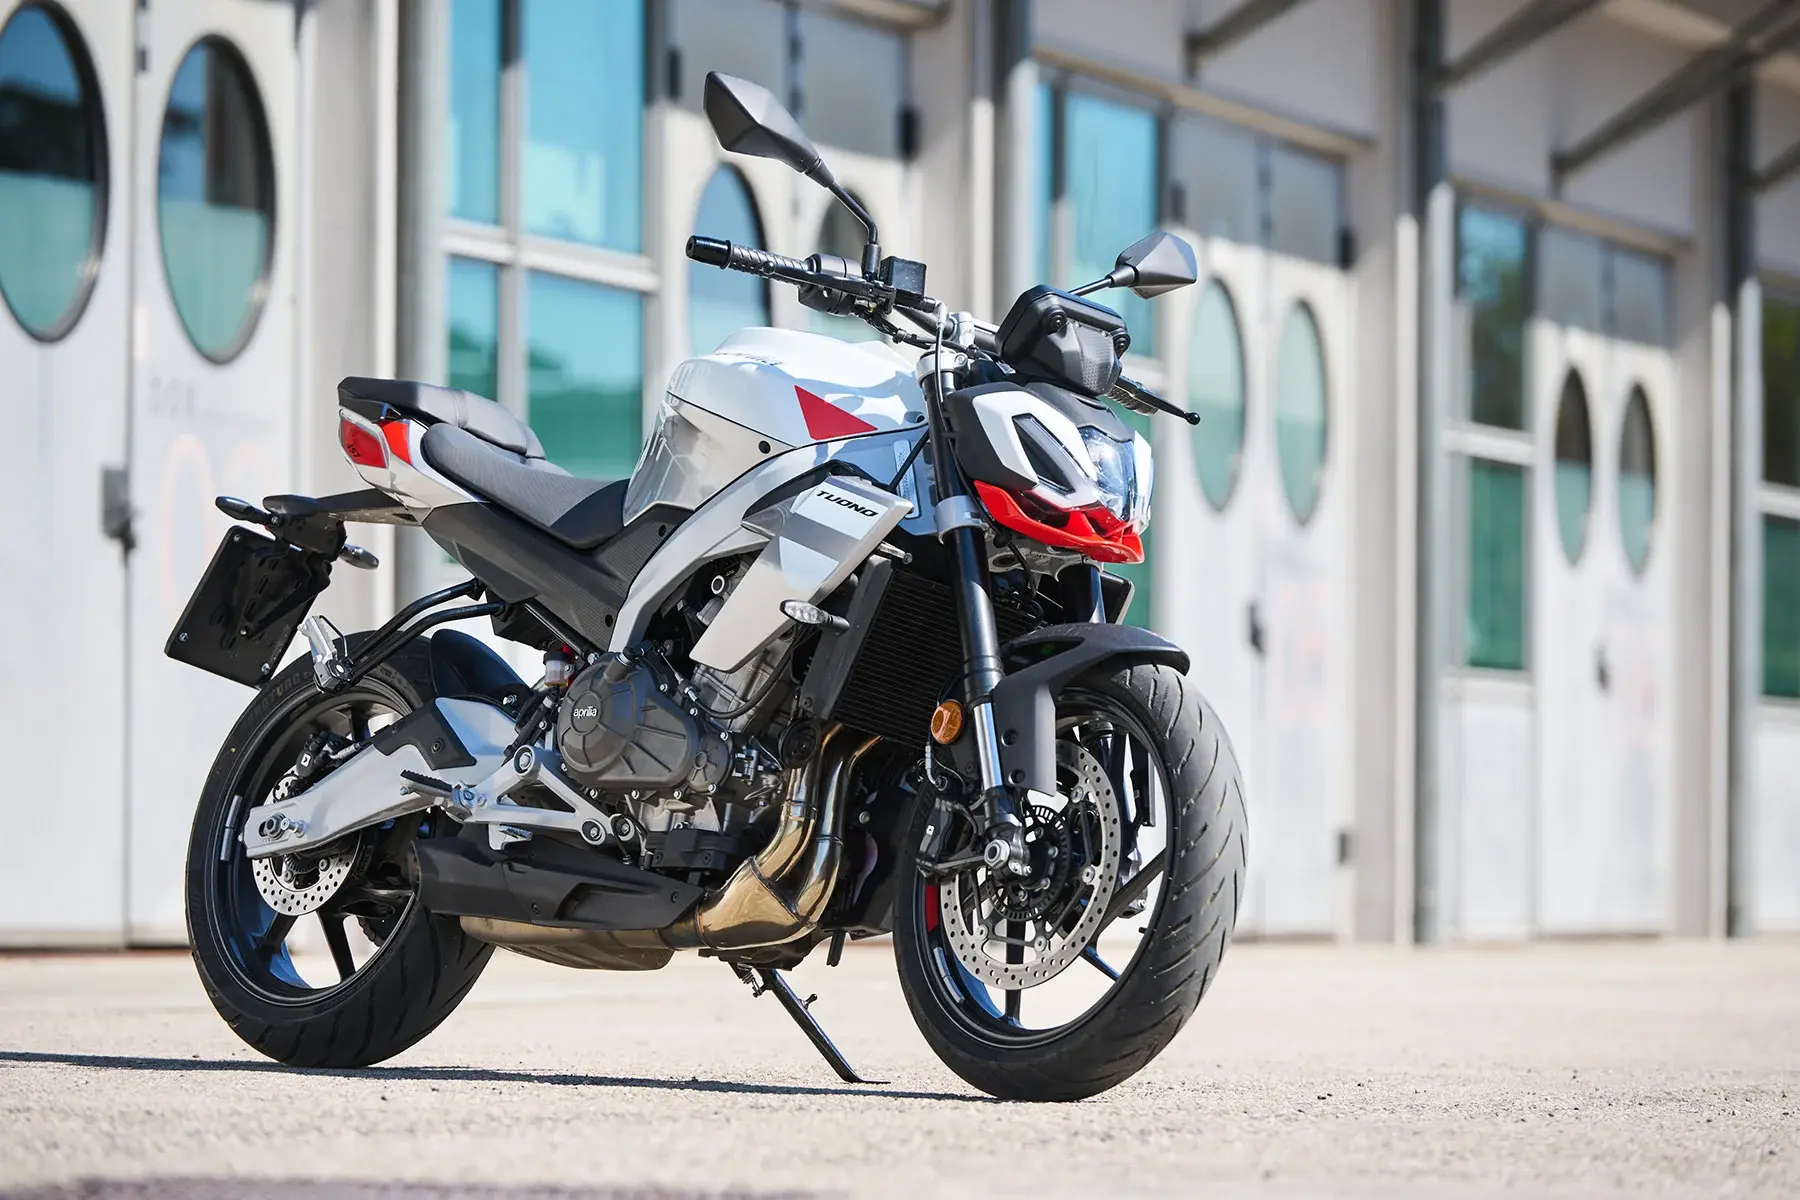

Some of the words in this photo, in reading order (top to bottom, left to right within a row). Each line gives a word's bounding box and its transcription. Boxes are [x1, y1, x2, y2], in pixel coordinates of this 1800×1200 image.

[346, 443, 361, 457] 457
[816, 490, 878, 517] TUONO
[573, 706, 598, 719] aprilia
